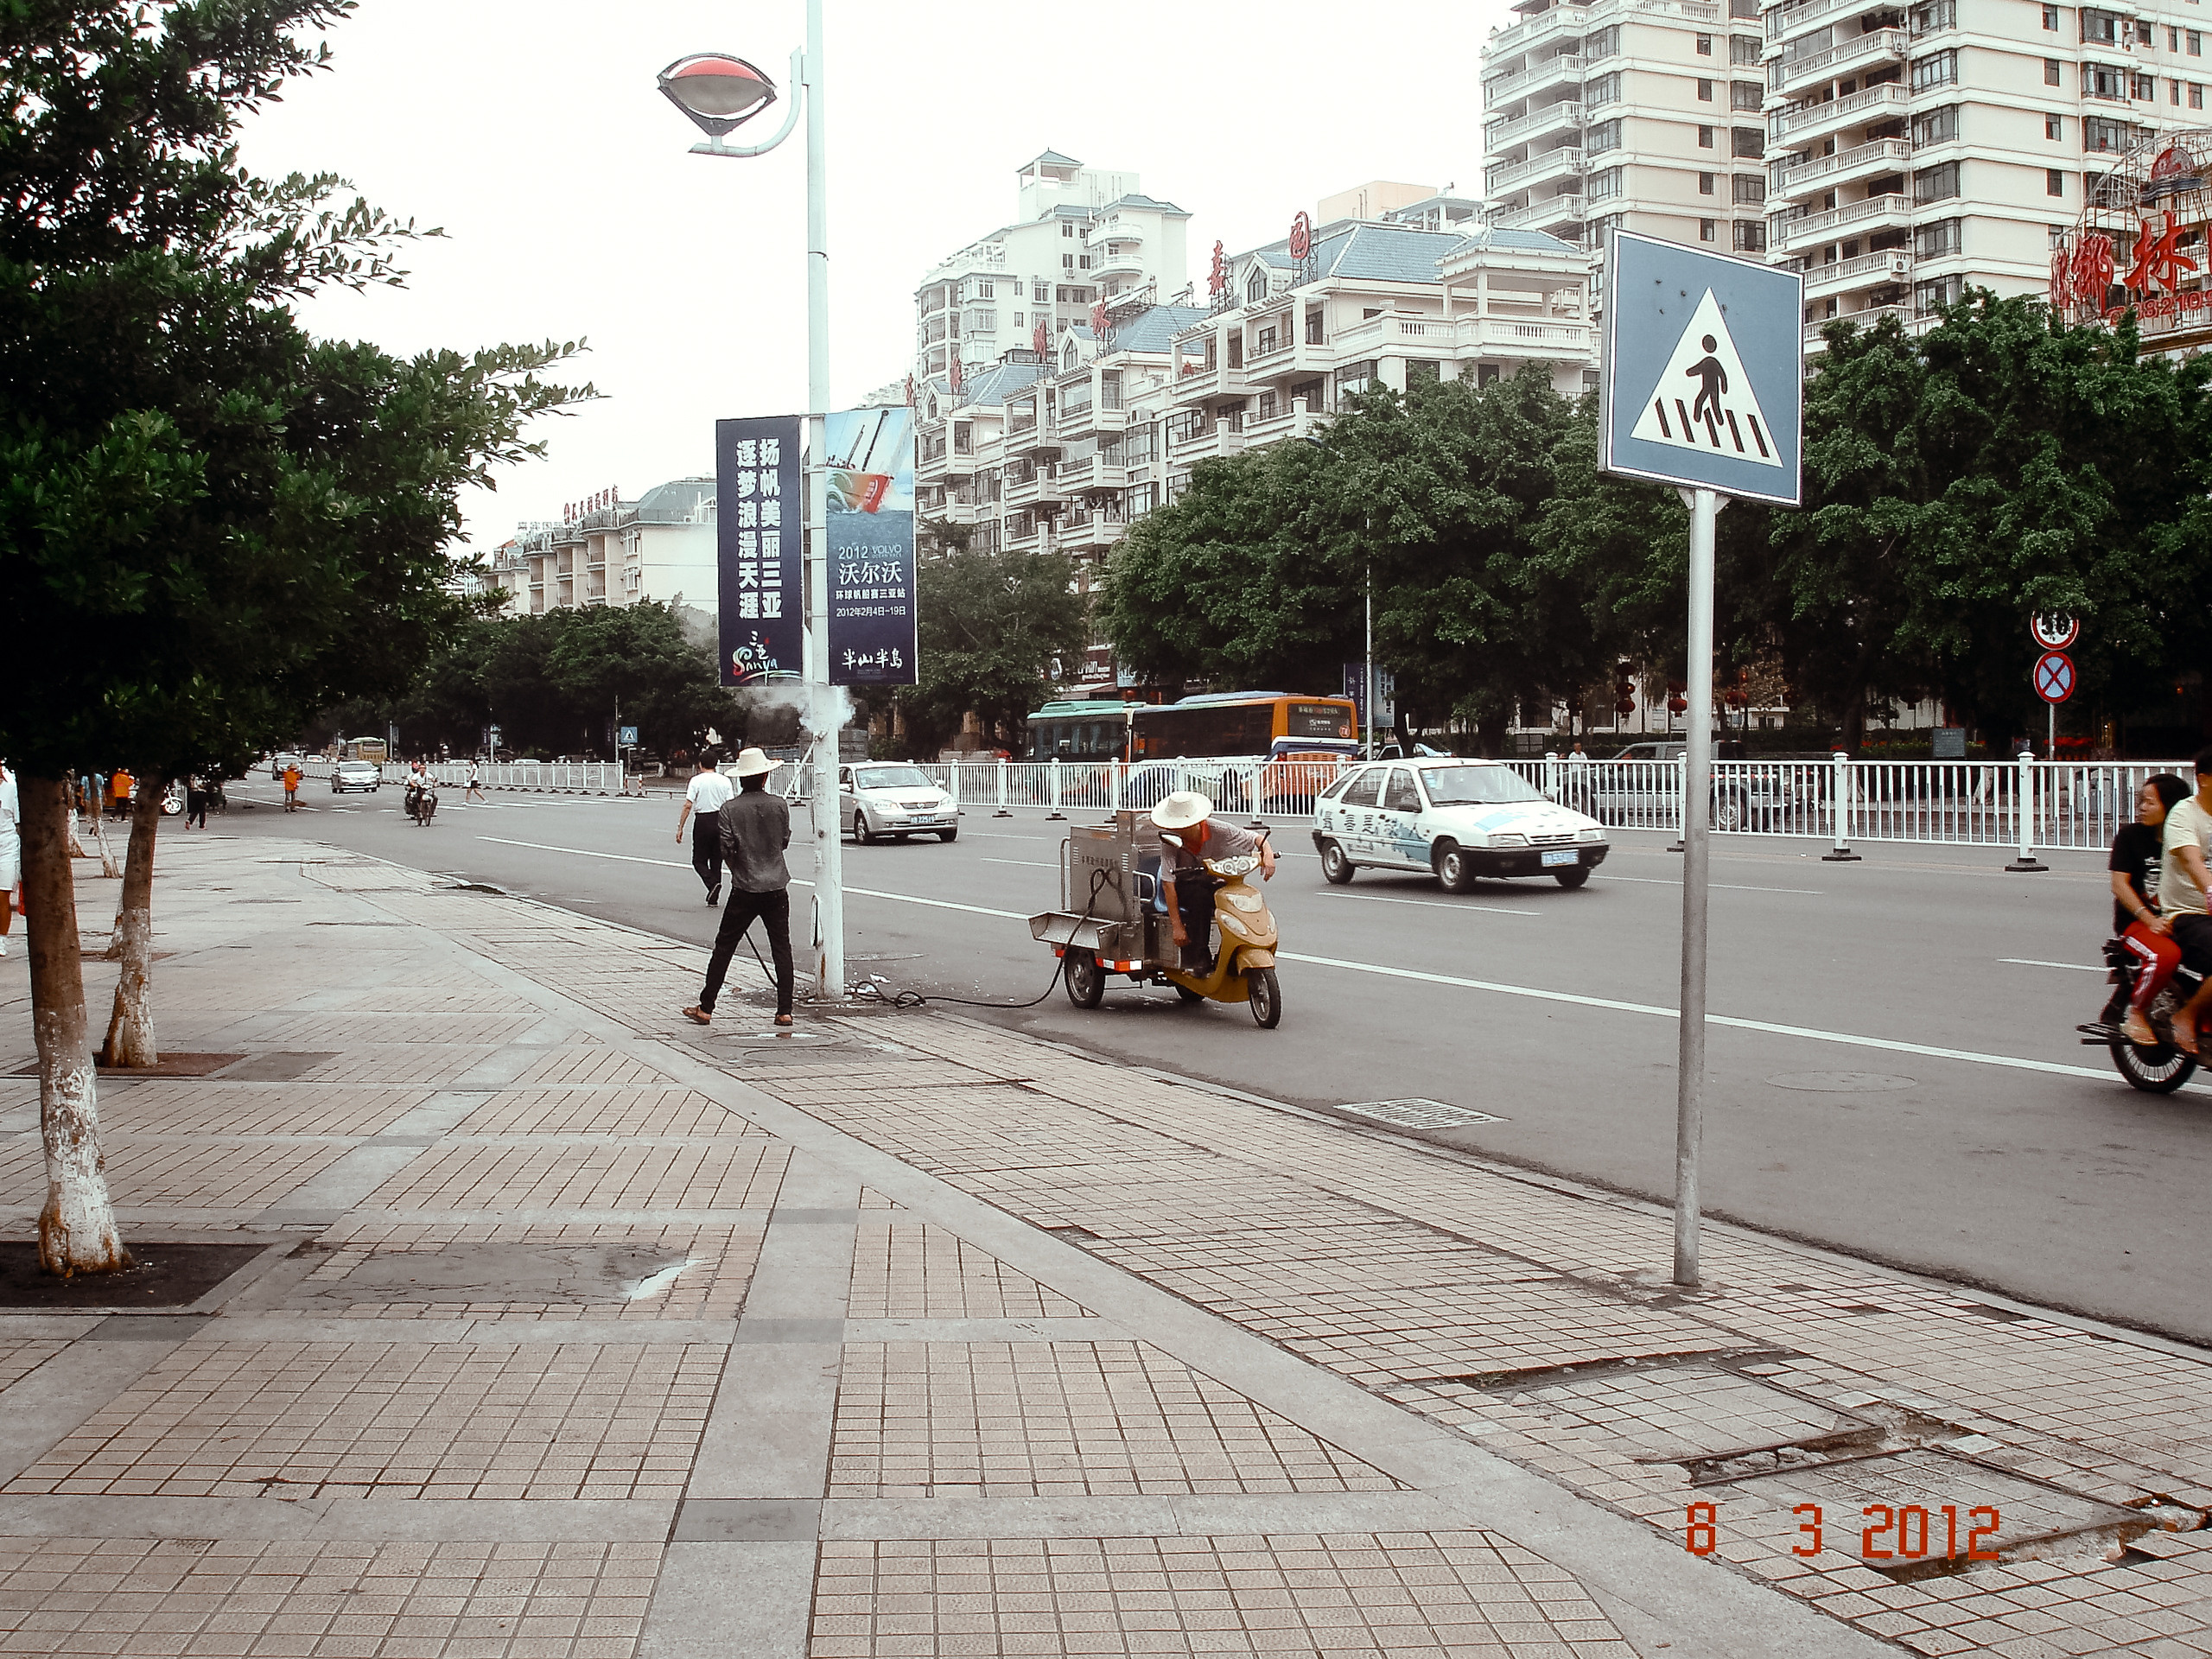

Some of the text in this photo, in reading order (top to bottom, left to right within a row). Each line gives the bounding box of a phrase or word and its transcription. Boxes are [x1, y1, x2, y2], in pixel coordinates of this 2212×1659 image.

[736, 439, 759, 620] 逐梦浪漫天涯
[760, 438, 782, 619] 扬帆美丽三亚
[838, 543, 902, 560] 2012 VOLVO
[838, 560, 903, 585] 沃尔沃
[836, 588, 906, 600] 环球帆船赛三亚站
[732, 645, 778, 686] Sanya
